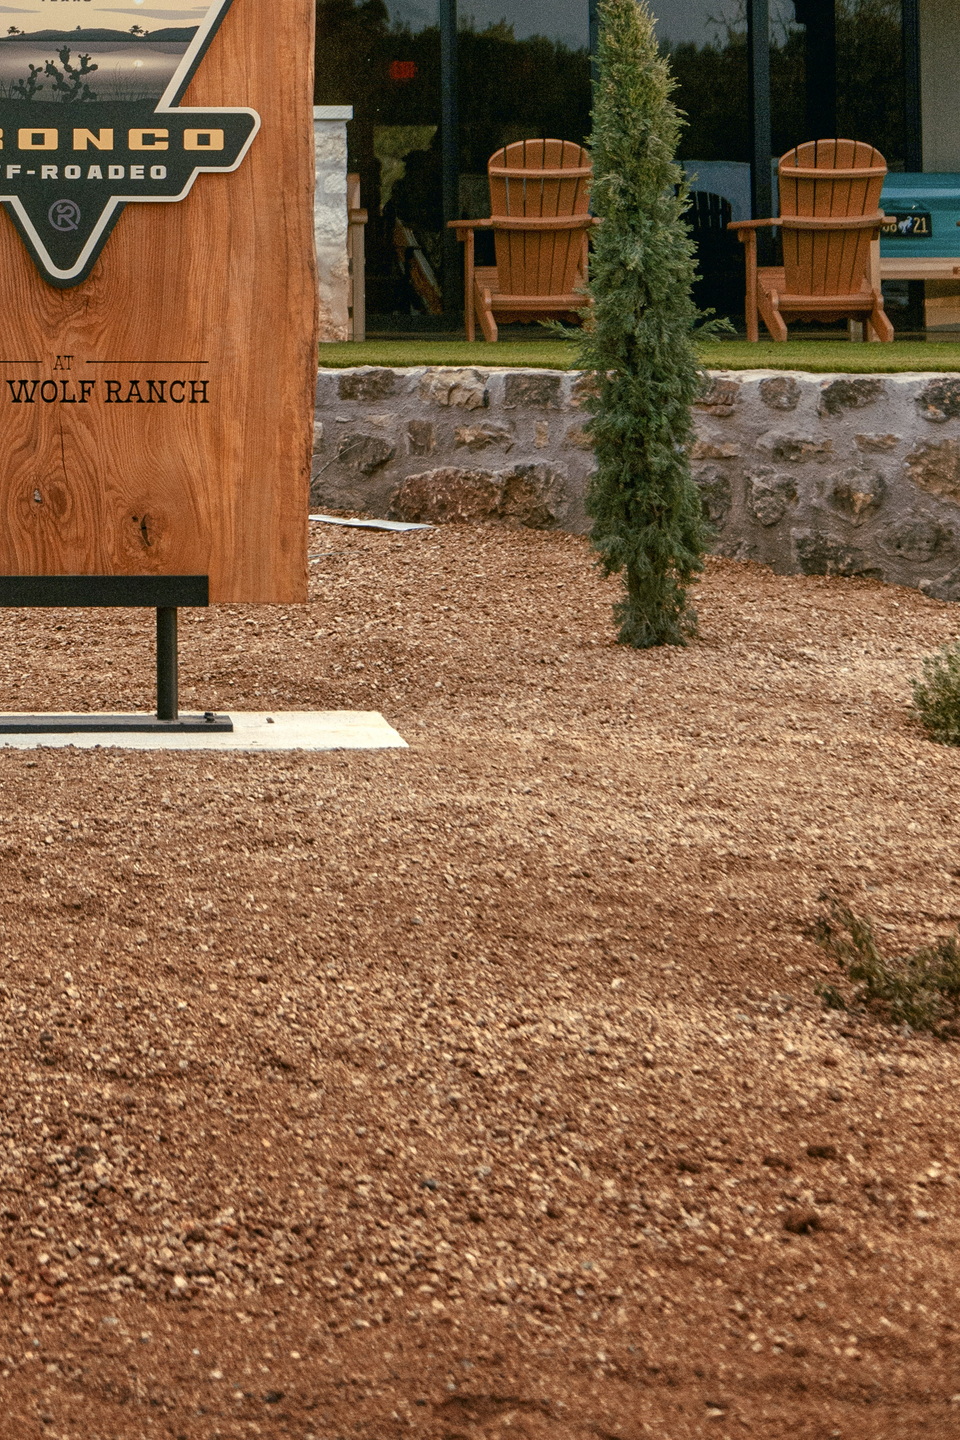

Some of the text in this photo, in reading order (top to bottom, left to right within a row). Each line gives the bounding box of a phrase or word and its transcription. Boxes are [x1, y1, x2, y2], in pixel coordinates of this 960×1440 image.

[913, 217, 928, 233] 21
[52, 355, 74, 371] AT
[6, 379, 96, 404] WOLF
[104, 379, 210, 404] RANCH
